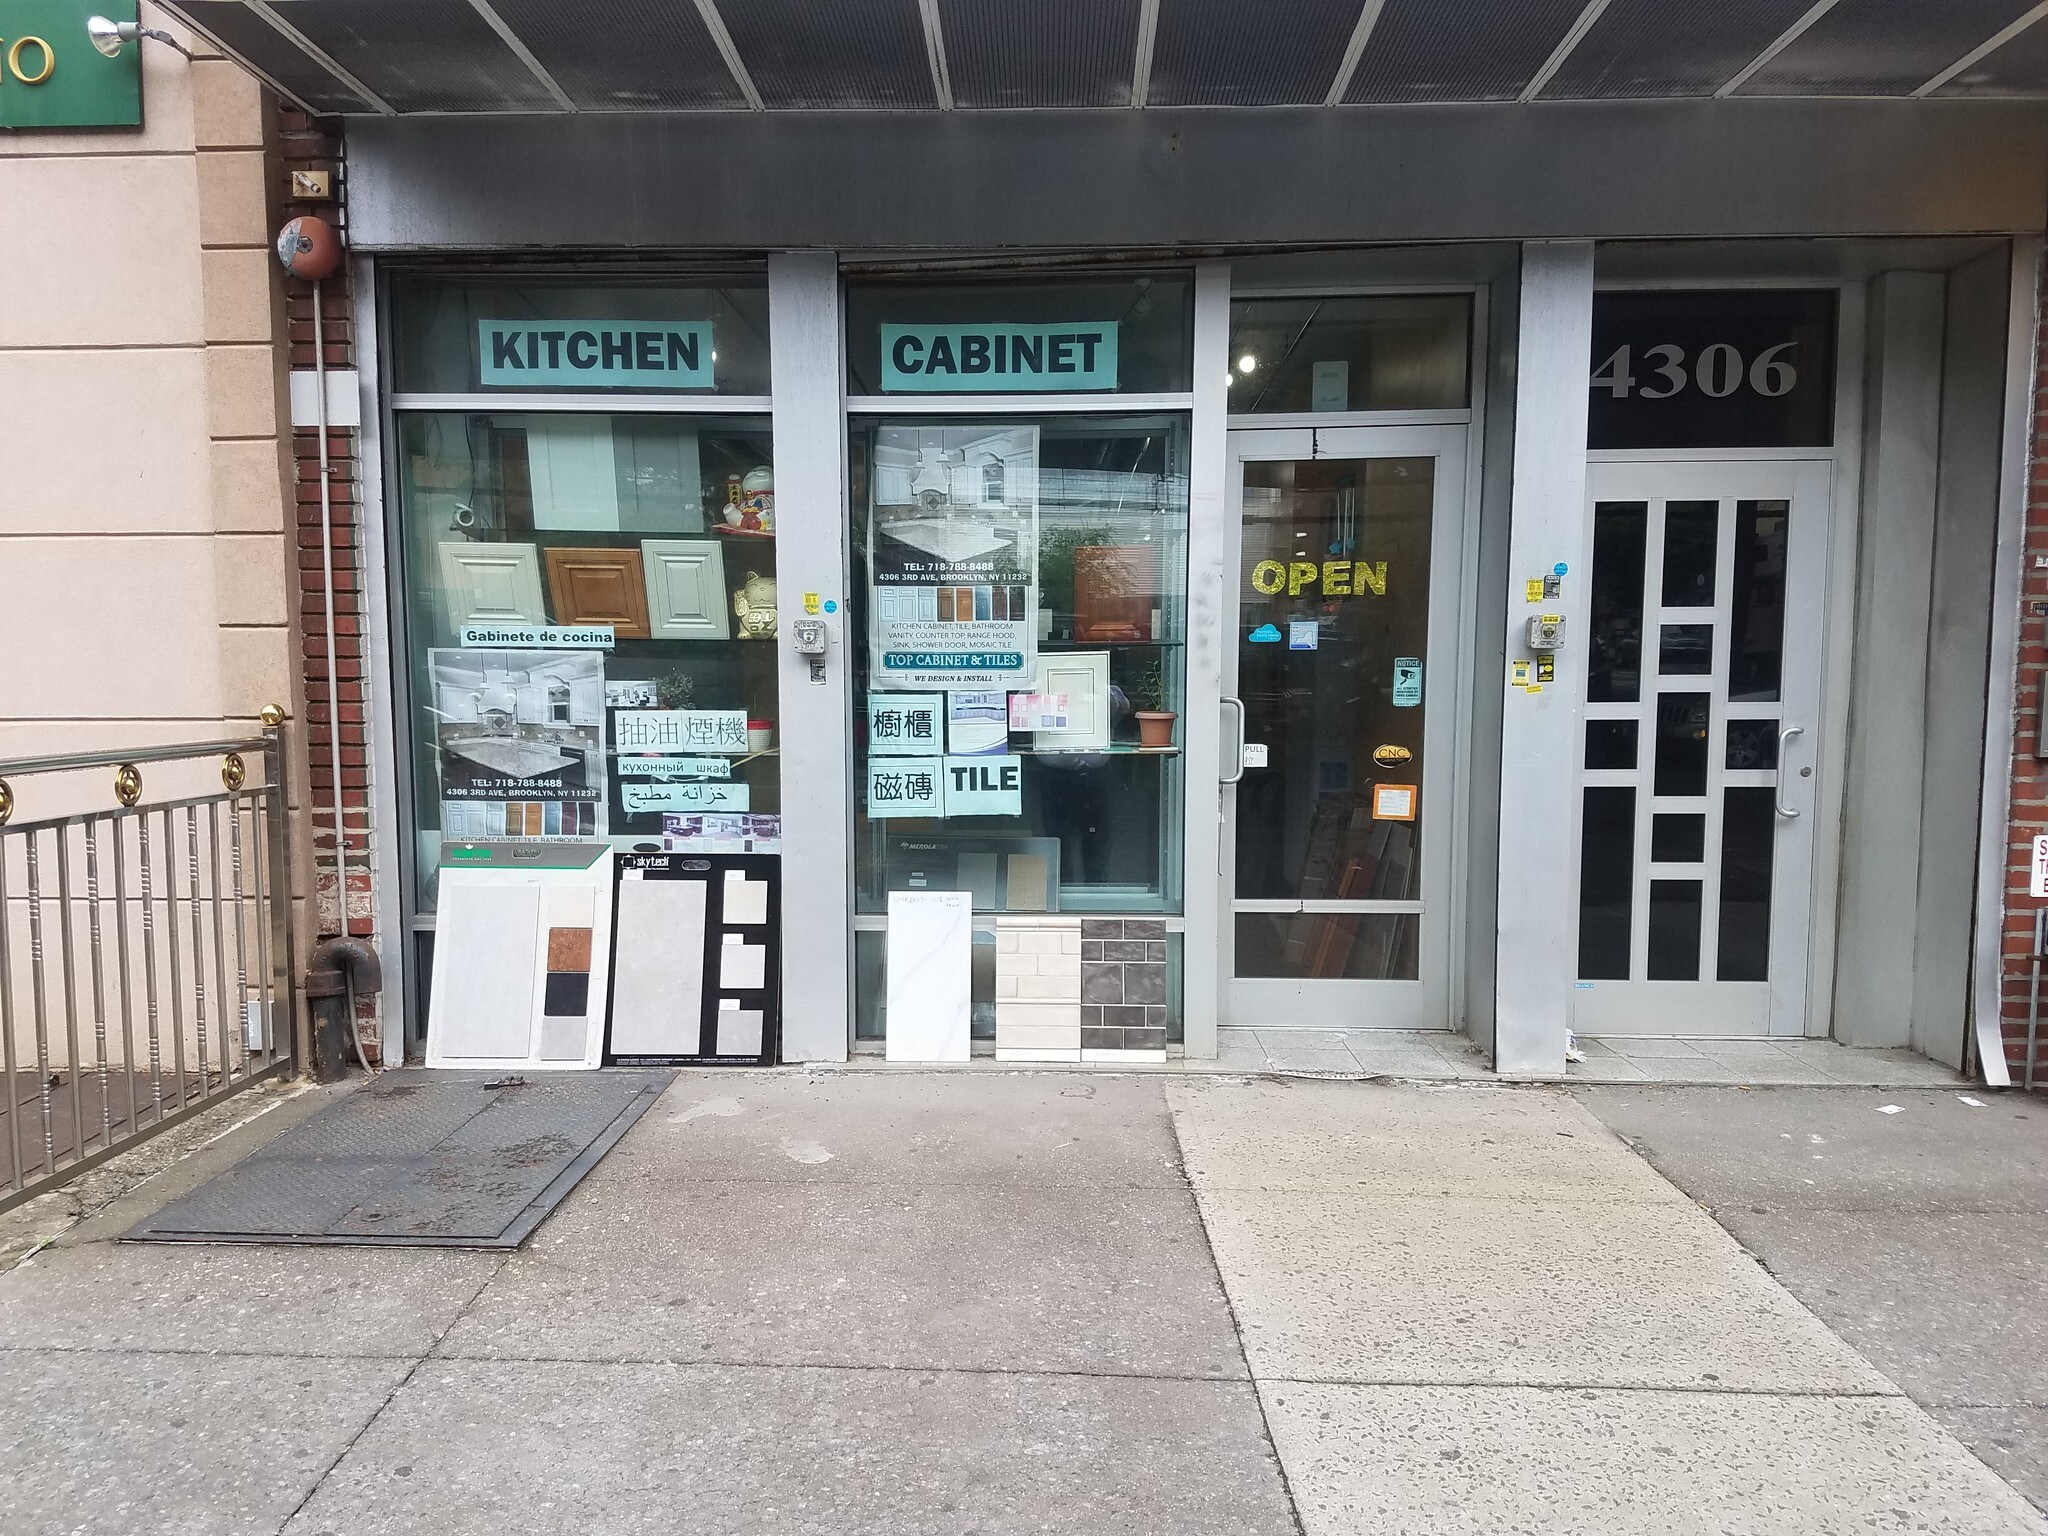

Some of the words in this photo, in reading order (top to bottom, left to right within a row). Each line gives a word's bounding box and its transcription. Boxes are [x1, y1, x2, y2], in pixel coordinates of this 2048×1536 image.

[0, 35, 55, 84] O
[491, 331, 700, 371] KITCHEN
[892, 333, 1103, 374] CABINET
[1590, 342, 1798, 398] 4306
[904, 563, 925, 571] TEL:
[928, 563, 994, 571] 718-788-8488
[879, 573, 900, 581] 4306
[901, 573, 918, 581] 3RD
[920, 574, 938, 582] AVE,
[941, 573, 987, 582] BROOKLYN,
[988, 573, 999, 581] NY
[1002, 573, 1027, 581] 11232
[1252, 560, 1388, 596] OPEN
[923, 623, 953, 631] CABINET,
[955, 623, 970, 631] TILE,
[466, 630, 534, 642] Gabinete
[539, 631, 558, 642] de
[562, 631, 613, 643] cocina
[888, 632, 914, 640] VANITY,
[951, 632, 966, 640] TOP,
[992, 632, 1017, 640] HOOD,
[888, 654, 913, 666] TOP
[915, 654, 969, 666] CABINET
[971, 655, 982, 666] &
[984, 654, 1018, 666] TILES
[873, 708, 933, 739] 櫥櫃
[618, 717, 746, 746] 抽油煙機
[1244, 745, 1265, 753] PULL
[1378, 748, 1407, 758] CNC
[622, 761, 684, 774] кухонный
[696, 763, 729, 776] шкаф
[471, 778, 492, 787] TEL:
[495, 778, 563, 787] 718-788-8488
[873, 772, 933, 801] 磁磚
[950, 766, 1019, 792] TILE
[446, 788, 468, 796] 4306
[469, 788, 486, 796] 3RD
[488, 789, 507, 797] AVE,
[508, 789, 556, 798] BROOKLYN,
[571, 789, 597, 797] 11232
[628, 785, 672, 808] مطبخ
[681, 785, 728, 804] خزانة
[636, 856, 670, 868] skytech
